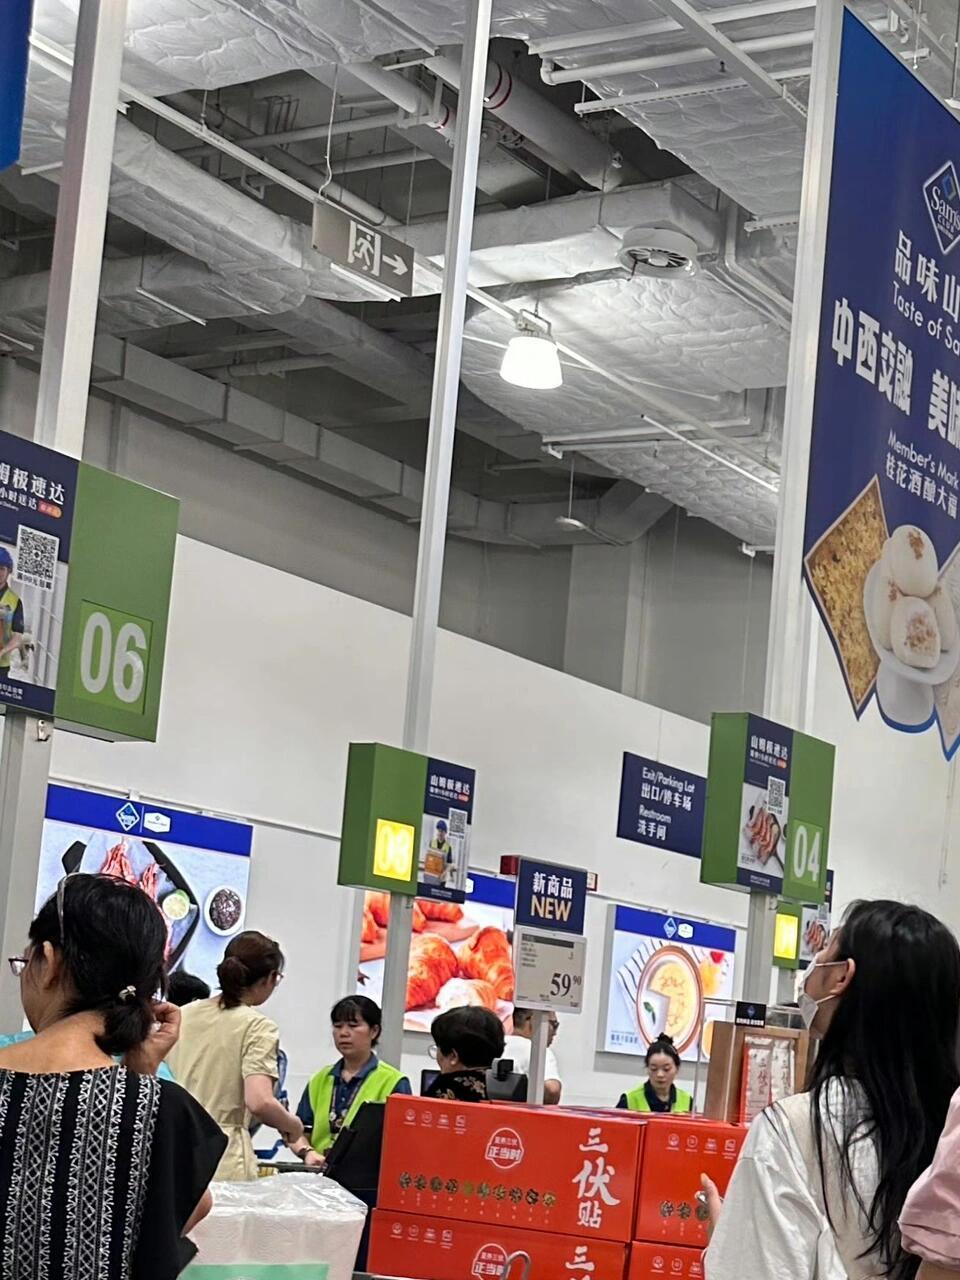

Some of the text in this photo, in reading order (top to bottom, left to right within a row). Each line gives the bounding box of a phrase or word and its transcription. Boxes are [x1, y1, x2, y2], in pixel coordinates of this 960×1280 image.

[892, 281, 923, 327] Taste
[927, 318, 943, 340] of
[831, 297, 914, 416] 中西交融
[885, 452, 958, 519] 桂花酒酿大福
[888, 429, 960, 490] Member's Mark
[80, 612, 147, 703] 06
[639, 804, 672, 824] Restroom
[641, 783, 692, 811] 出口/停车场
[637, 819, 666, 841] 洗手间
[792, 825, 821, 882] 04
[530, 894, 572, 922] NEW
[532, 872, 573, 899] 新商品
[488, 1146, 522, 1161] 正当时
[572, 1127, 621, 1229] 三伏贴
